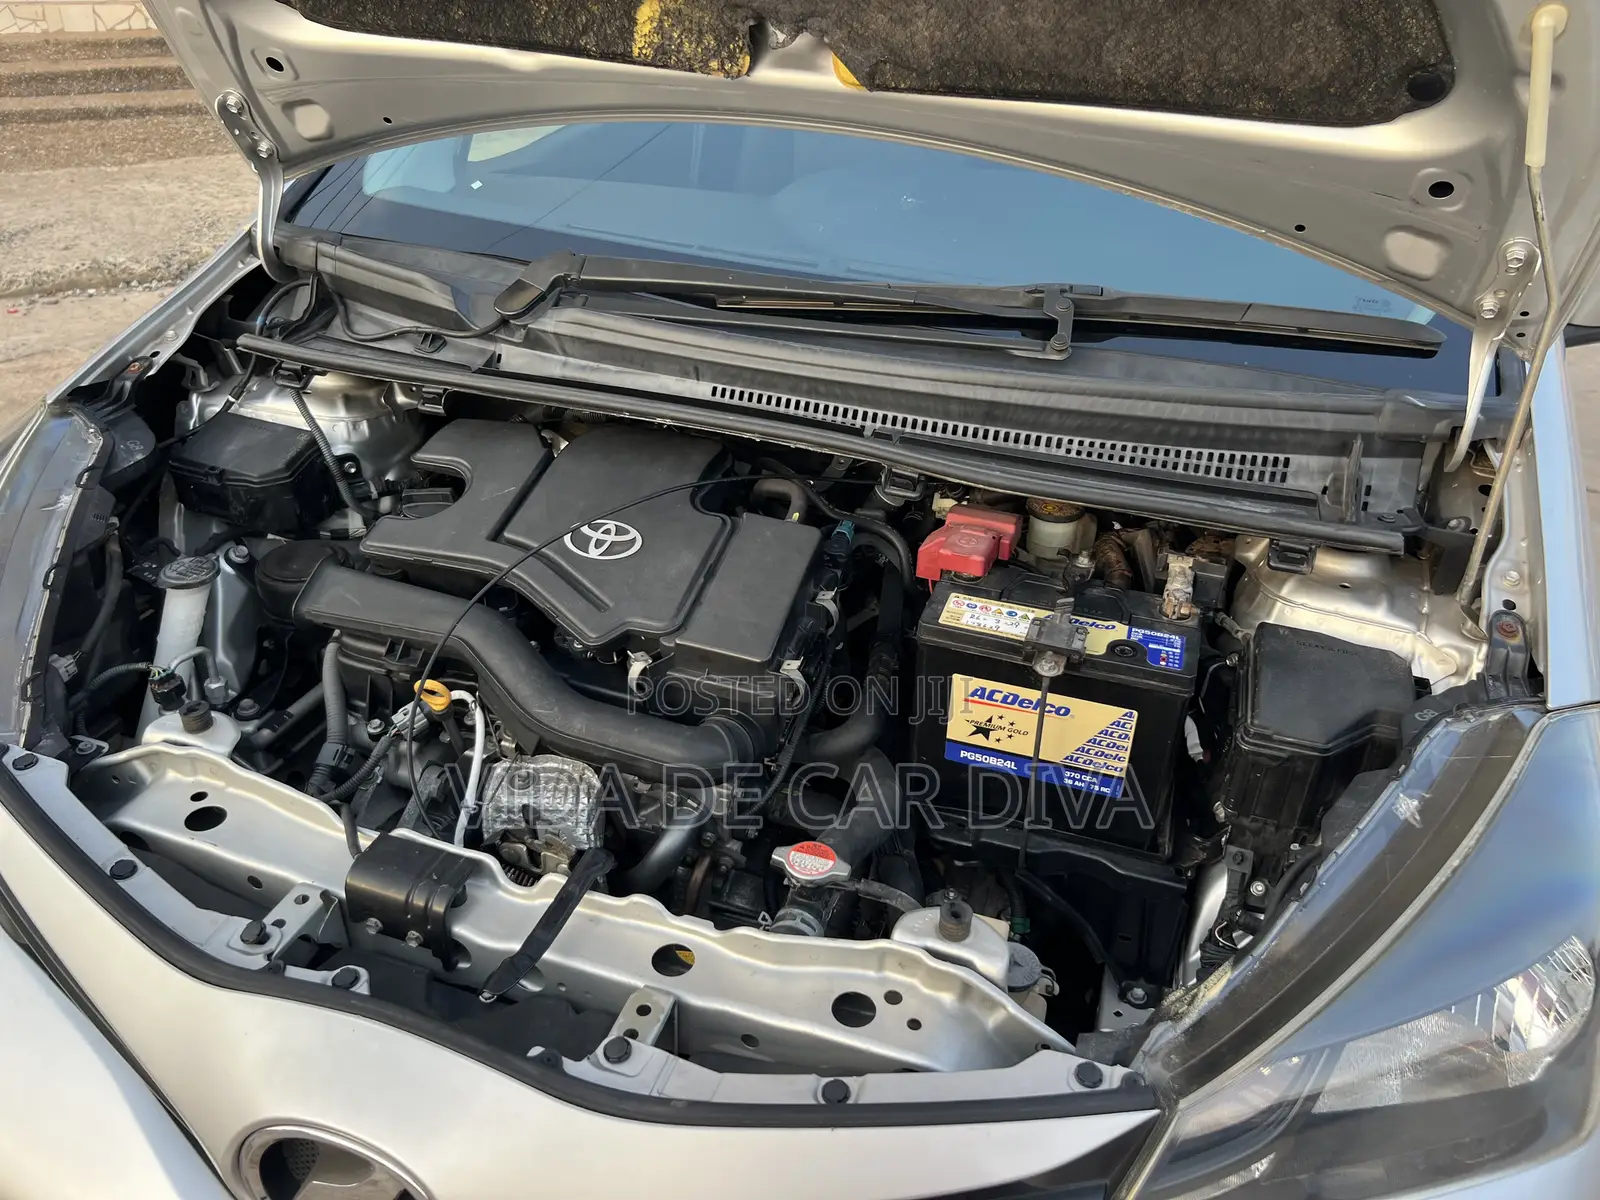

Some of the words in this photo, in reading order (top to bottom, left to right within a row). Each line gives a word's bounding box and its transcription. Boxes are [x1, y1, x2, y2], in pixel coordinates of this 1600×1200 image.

[968, 686, 1071, 717] ACDelco
[969, 719, 1006, 732] PREMIUM
[1007, 726, 1029, 737] GOLD
[1097, 728, 1131, 741] ACD
[959, 749, 1018, 770] PG50B24L
[1062, 754, 1125, 773] ACDelco
[1064, 770, 1081, 780] 370
[1081, 774, 1098, 784] CCA
[1100, 786, 1111, 794] RC
